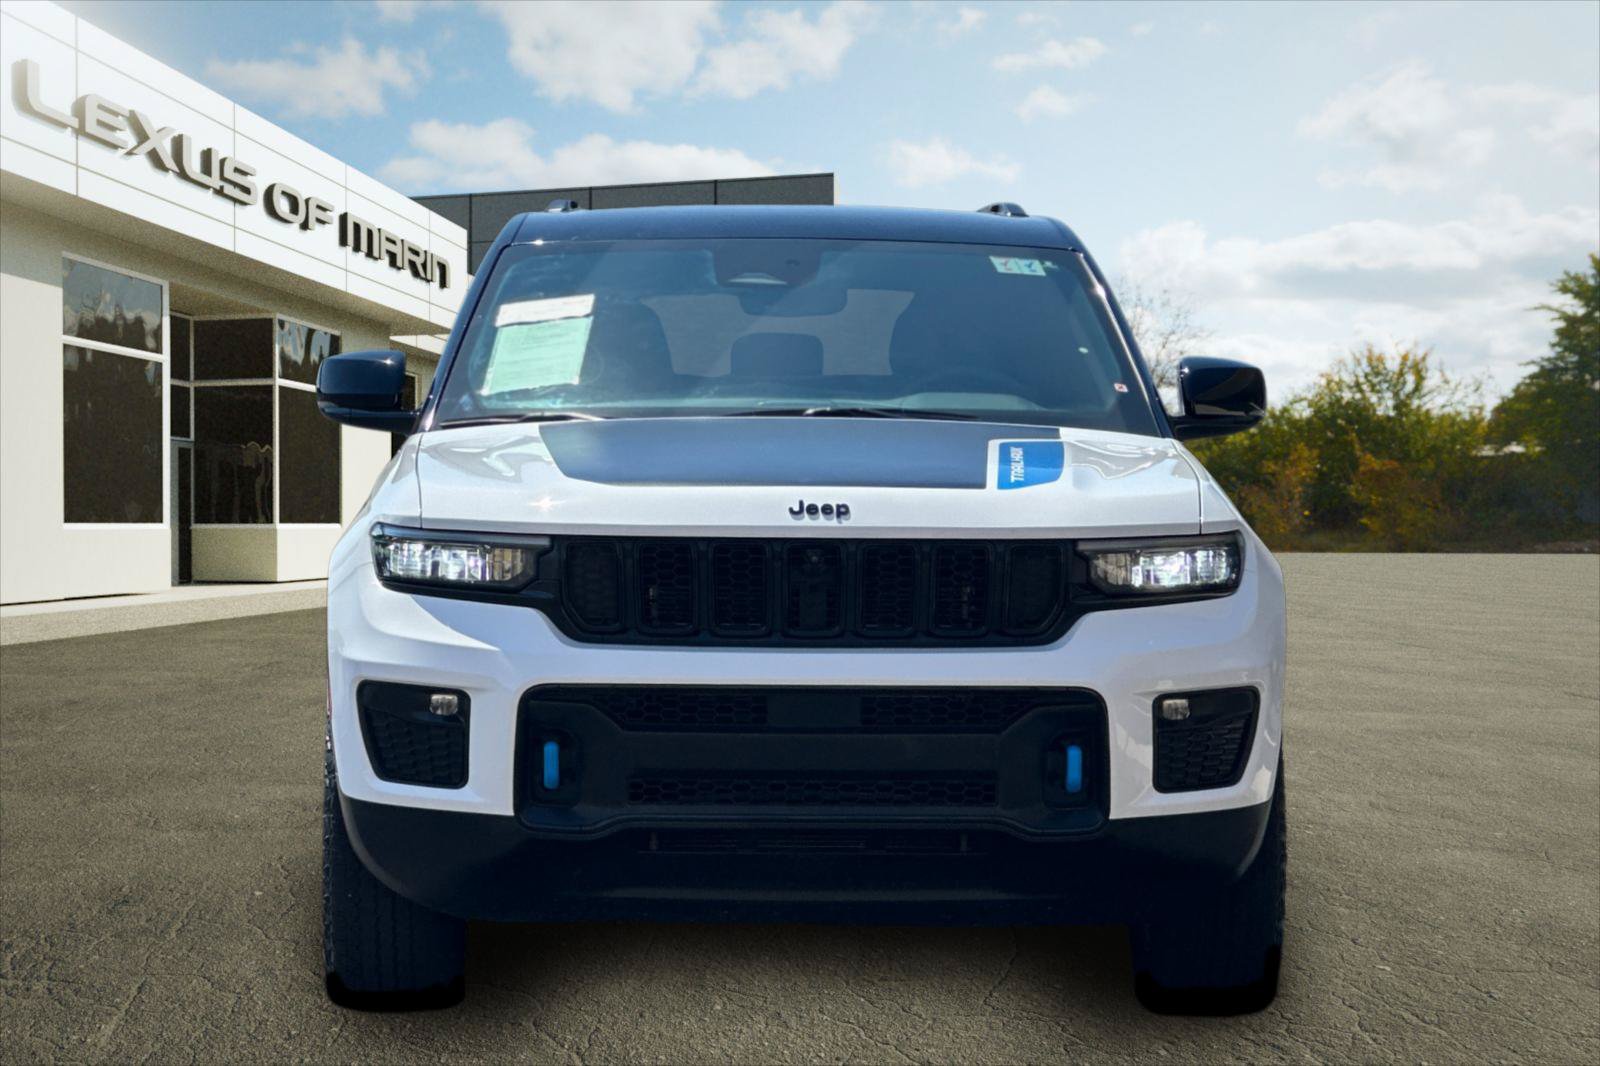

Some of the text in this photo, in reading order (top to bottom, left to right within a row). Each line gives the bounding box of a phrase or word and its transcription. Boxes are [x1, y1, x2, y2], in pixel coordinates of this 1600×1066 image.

[11, 58, 452, 290] LEXUS OF MARIN
[788, 499, 851, 519] Jeep
